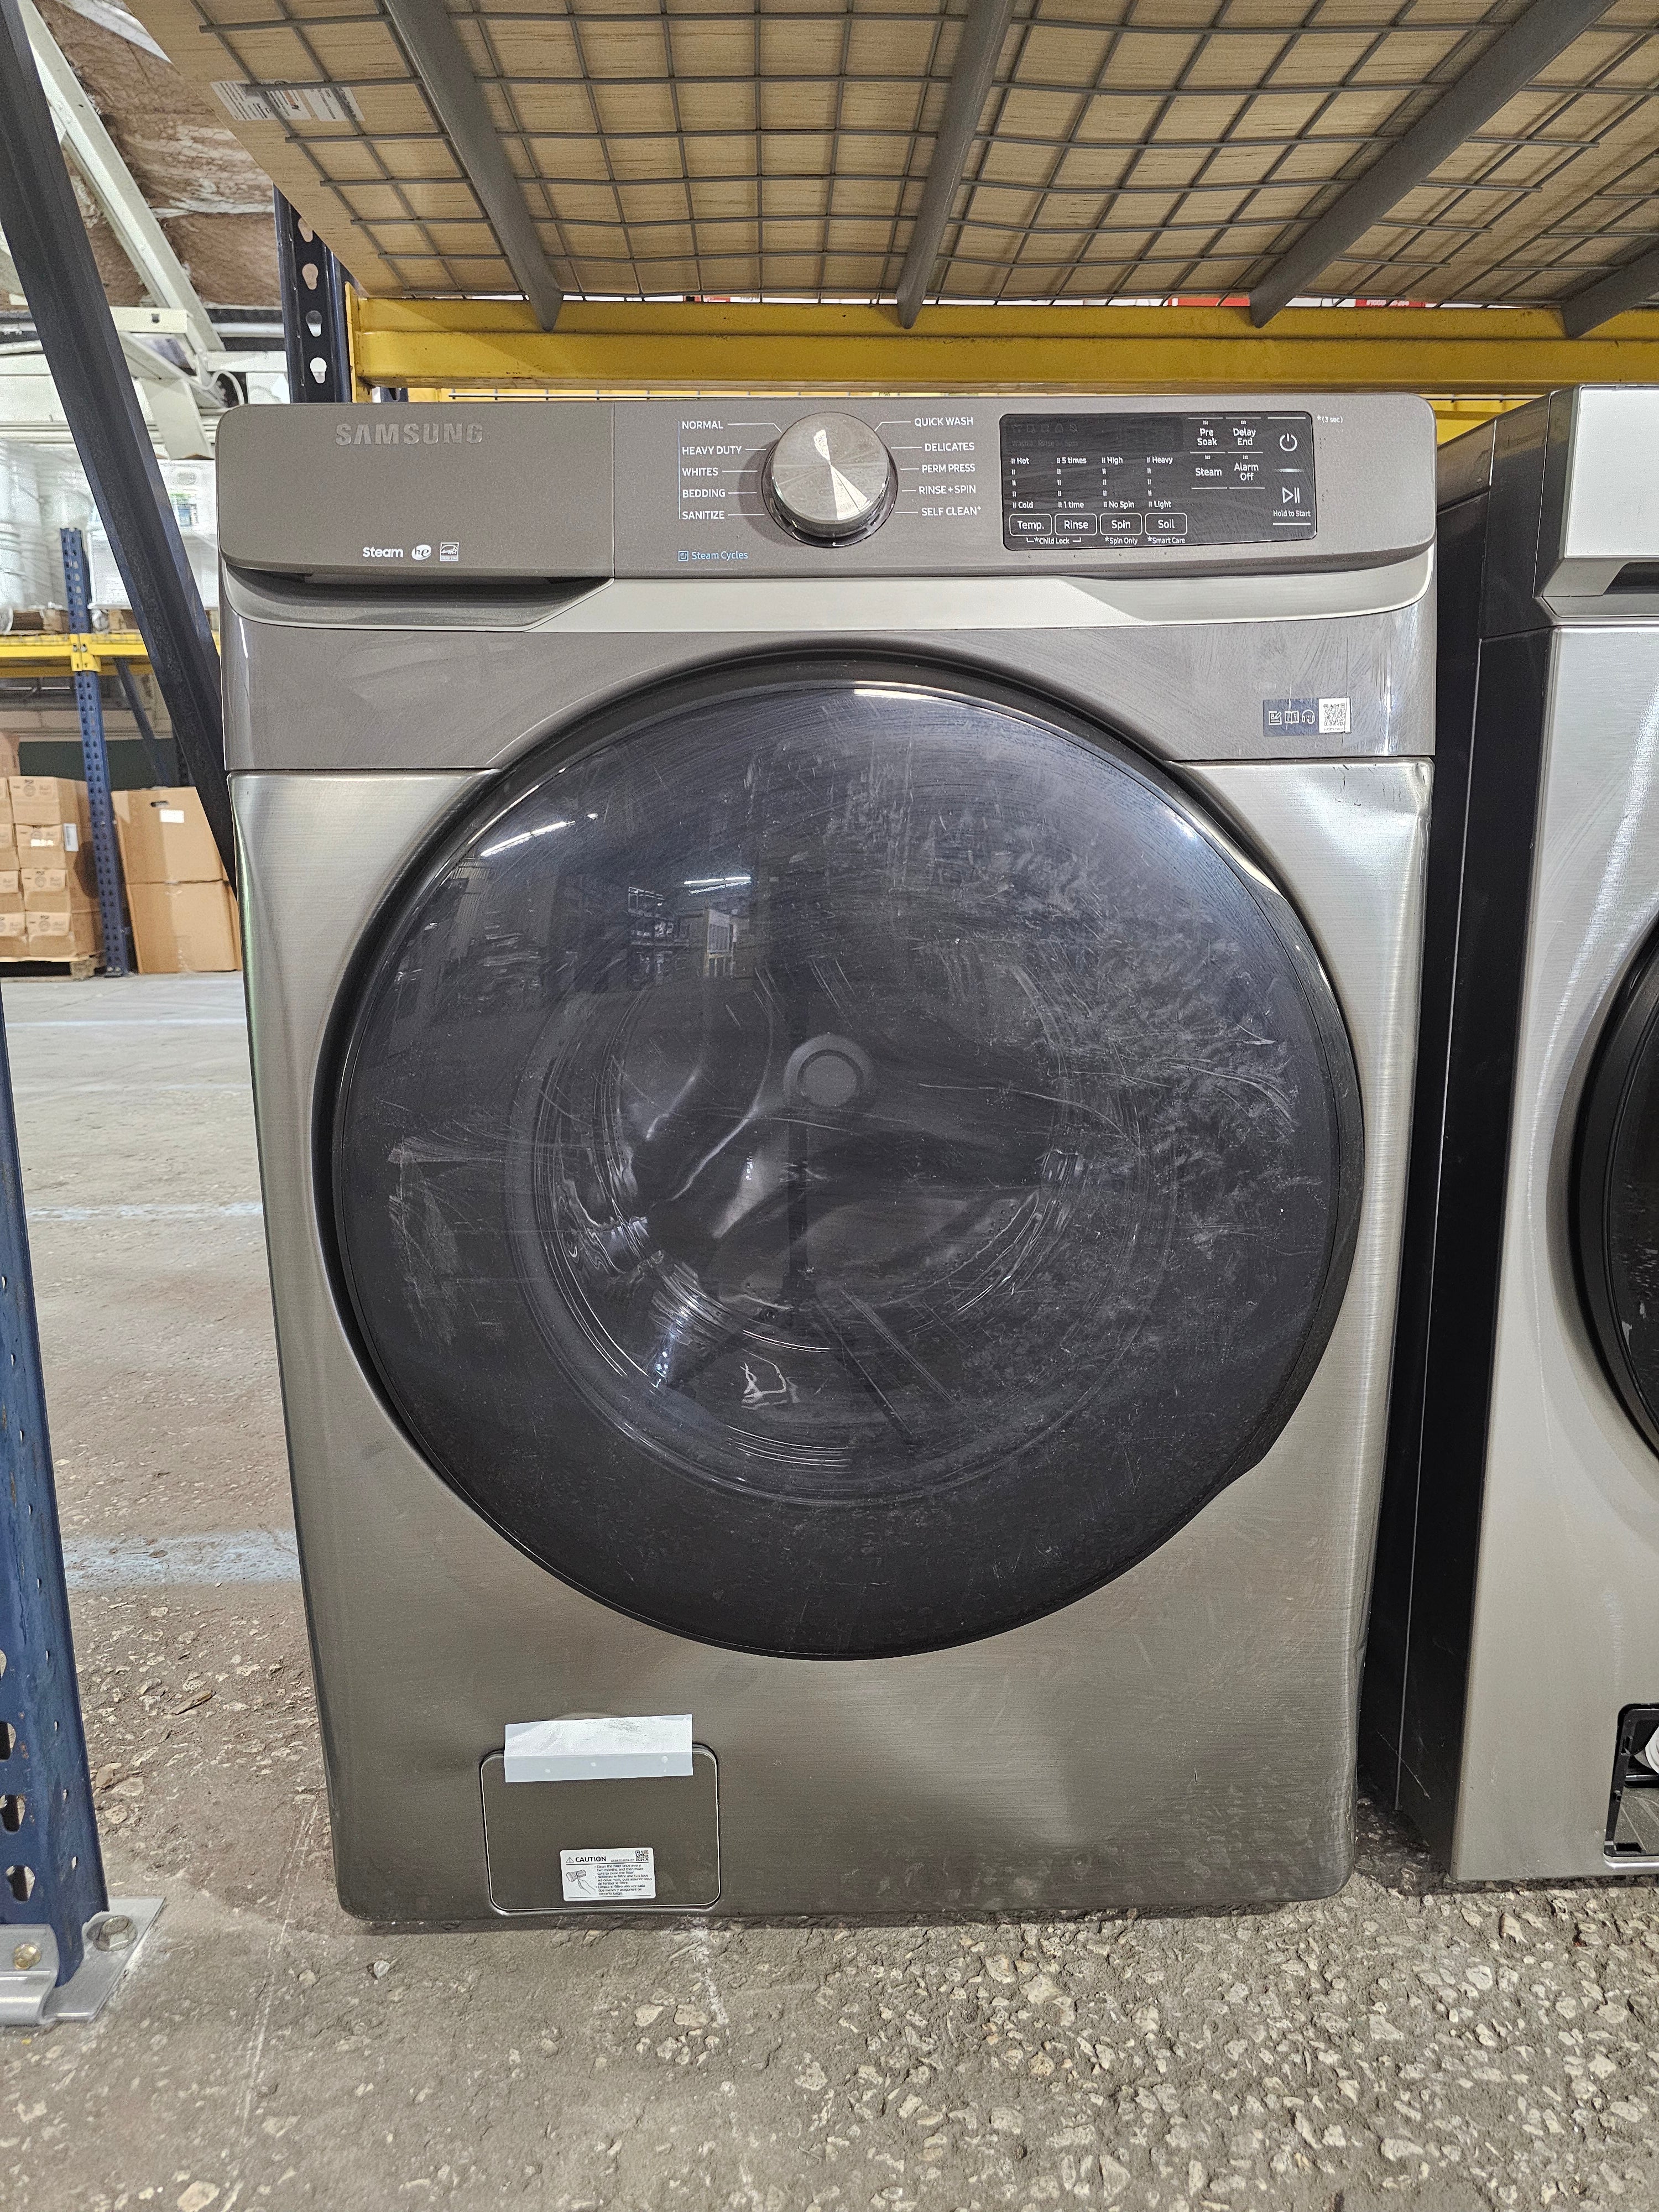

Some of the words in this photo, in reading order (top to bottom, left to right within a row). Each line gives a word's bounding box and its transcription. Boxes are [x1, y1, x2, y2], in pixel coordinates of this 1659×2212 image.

[682, 421, 723, 429] NORMAL
[915, 418, 943, 427] QUICK
[945, 417, 973, 425] WASH
[335, 424, 483, 446] SAMSUNG
[1233, 428, 1256, 438] Delay
[1238, 436, 1253, 445] End
[682, 446, 714, 455] HEAVY
[925, 442, 974, 451] DELICATES
[682, 467, 718, 476] WHITES
[922, 465, 946, 473] PERM
[948, 463, 975, 472] PRESS
[1240, 472, 1254, 481] Off
[683, 489, 725, 498] BEDDING
[1154, 500, 1171, 509] Light
[682, 511, 724, 519] SANITIZE
[922, 508, 942, 516] SELF
[1018, 521, 1044, 530] Temp.
[1065, 520, 1088, 529] Rinse
[1112, 520, 1130, 530] Spin
[1158, 519, 1175, 528] Soil
[363, 547, 403, 557] Steam
[721, 551, 748, 561] Cycles
